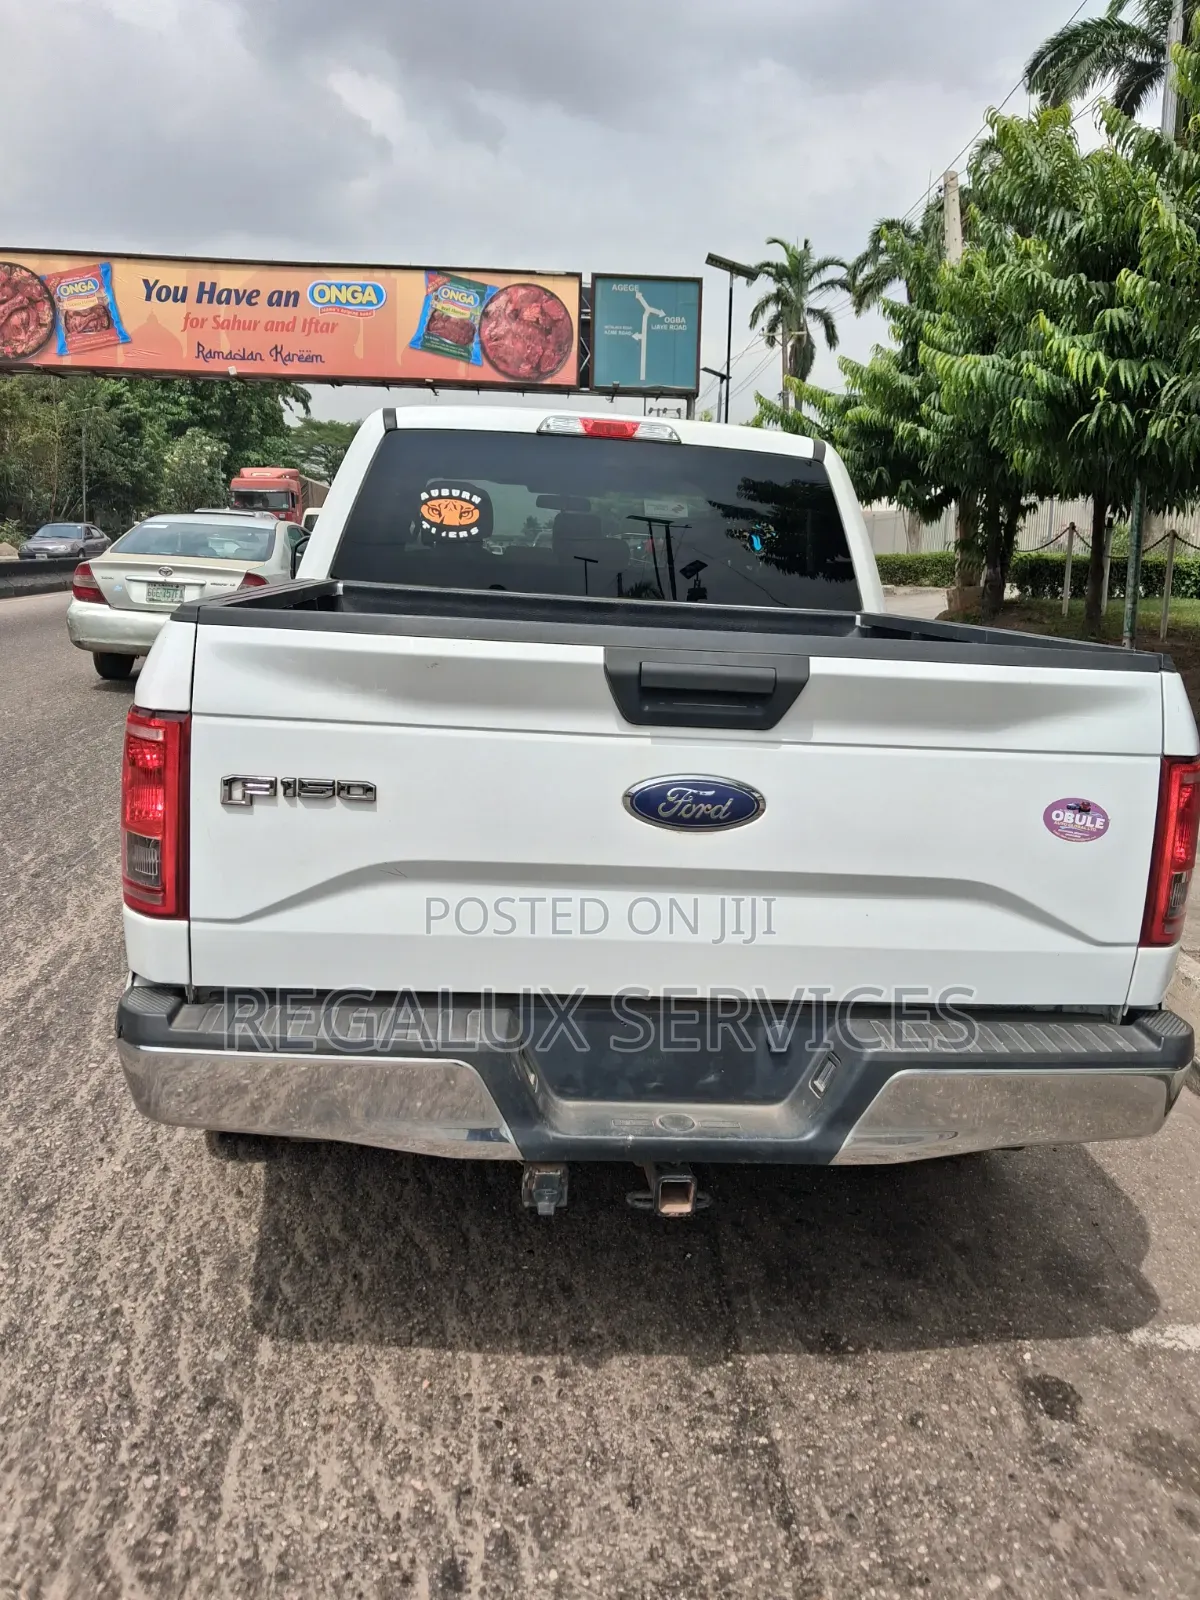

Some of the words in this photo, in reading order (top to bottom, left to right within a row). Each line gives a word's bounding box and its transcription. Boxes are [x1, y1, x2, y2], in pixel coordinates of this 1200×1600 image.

[60, 280, 96, 296] ONGA
[142, 279, 188, 303] You
[196, 281, 261, 307] Have
[267, 289, 300, 308] an
[313, 284, 378, 305] ONGA
[441, 287, 475, 306] ONGA
[612, 284, 639, 292] AGEGE
[181, 312, 208, 332] for
[212, 315, 260, 332] Sahur
[264, 316, 297, 332] and
[301, 317, 339, 337] Iftar
[664, 316, 686, 324] OGBA
[195, 341, 265, 363] Ramadan
[420, 488, 481, 504] AUBURN
[657, 787, 734, 820] Ford
[1051, 809, 1106, 829] OBULE
